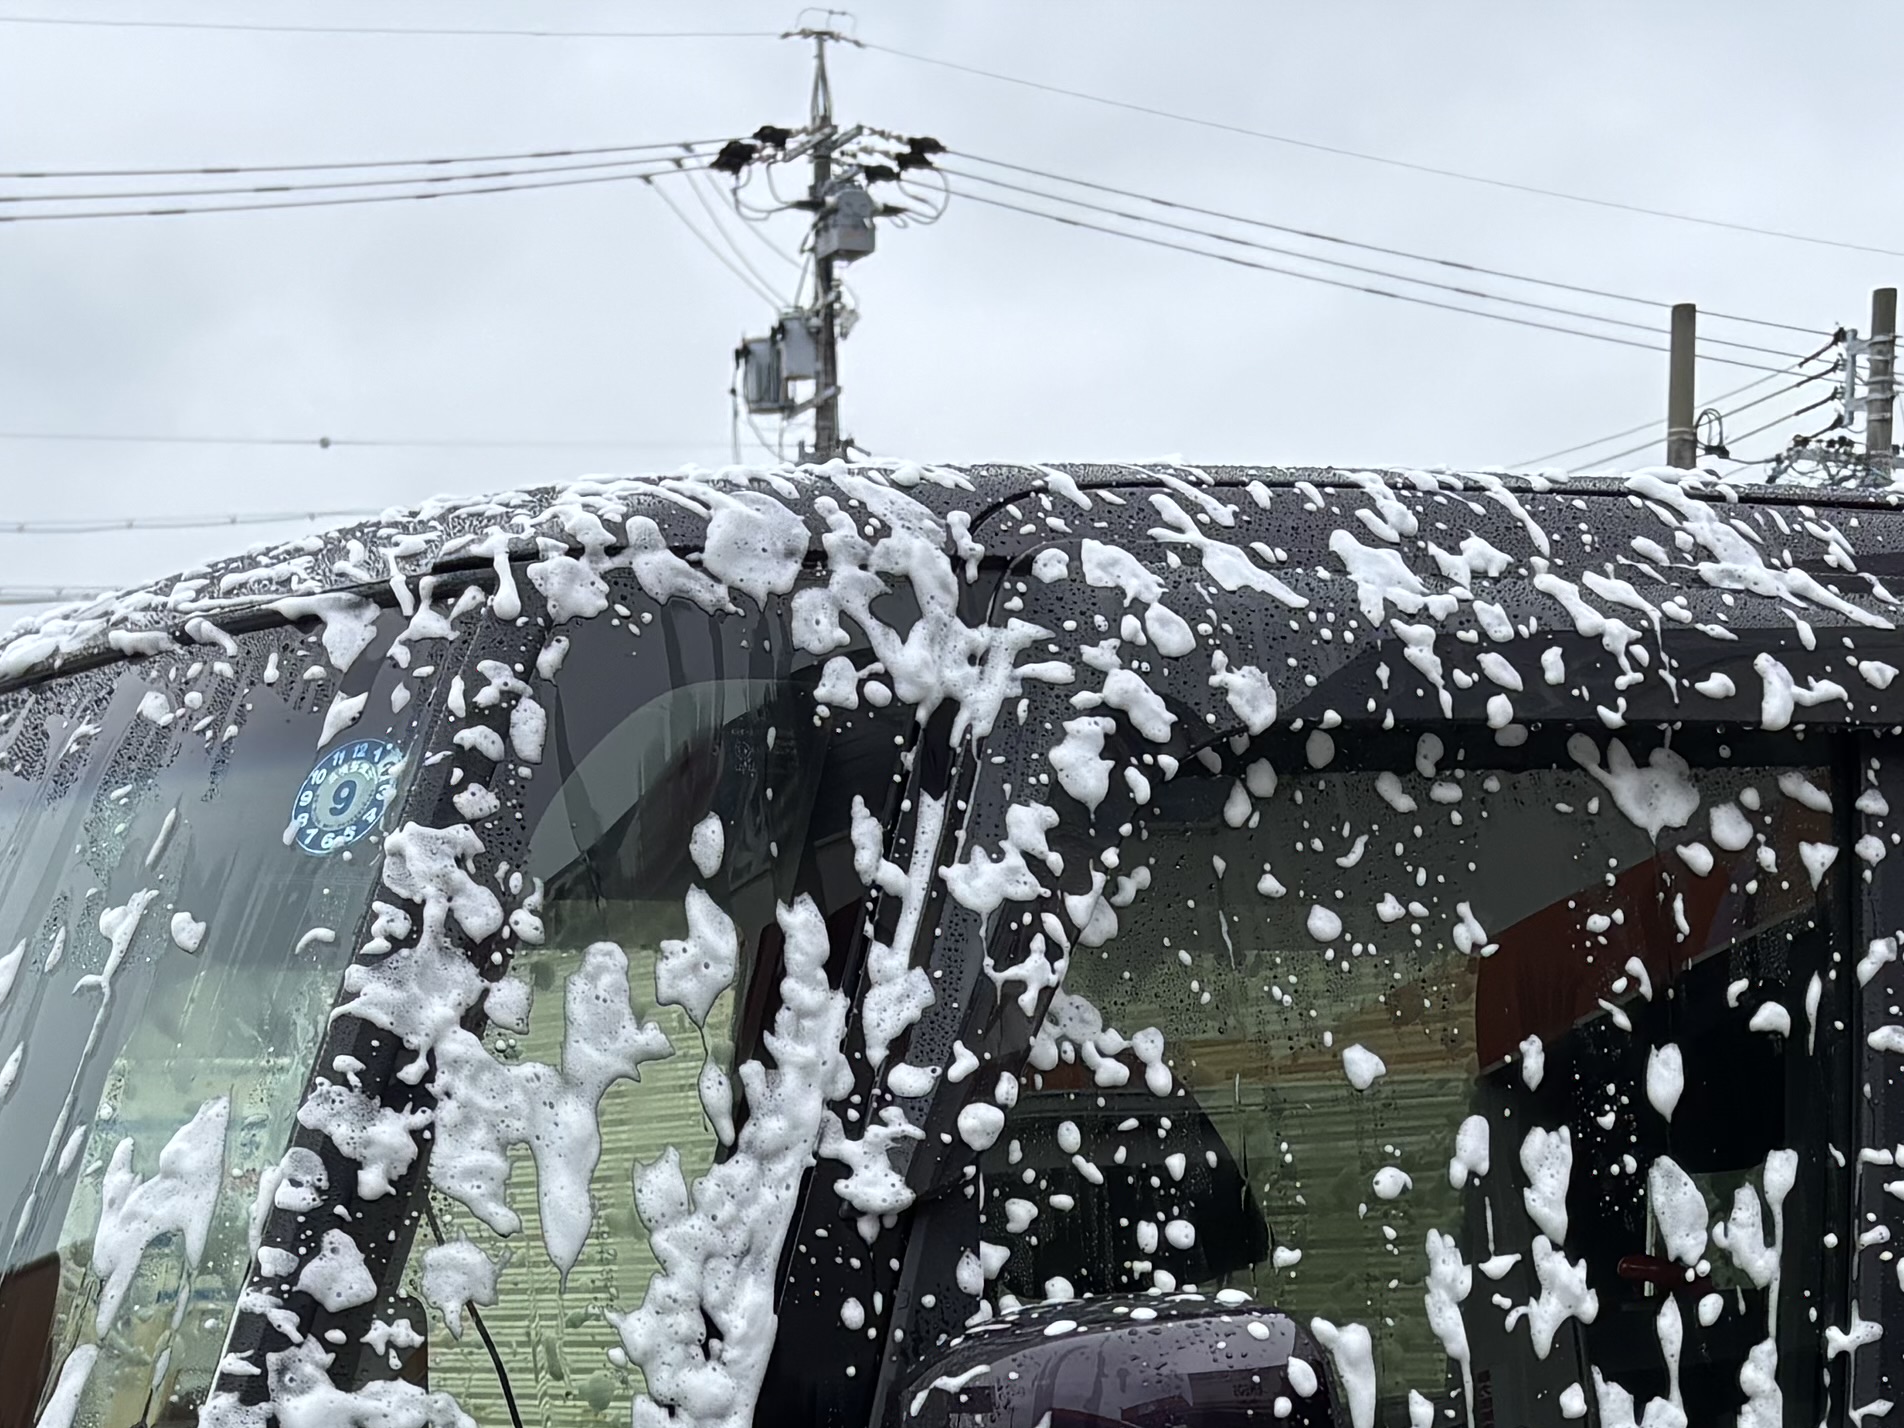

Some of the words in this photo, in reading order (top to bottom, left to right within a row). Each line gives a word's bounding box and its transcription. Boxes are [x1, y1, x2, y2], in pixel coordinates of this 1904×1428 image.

[332, 750, 346, 767] 11
[352, 742, 369, 759] 12
[373, 746, 383, 762] 1
[311, 768, 328, 785] 10
[299, 790, 314, 807] 9
[329, 779, 358, 817] 9
[362, 807, 377, 823] 4
[304, 828, 319, 844] 7
[321, 832, 336, 849] 6
